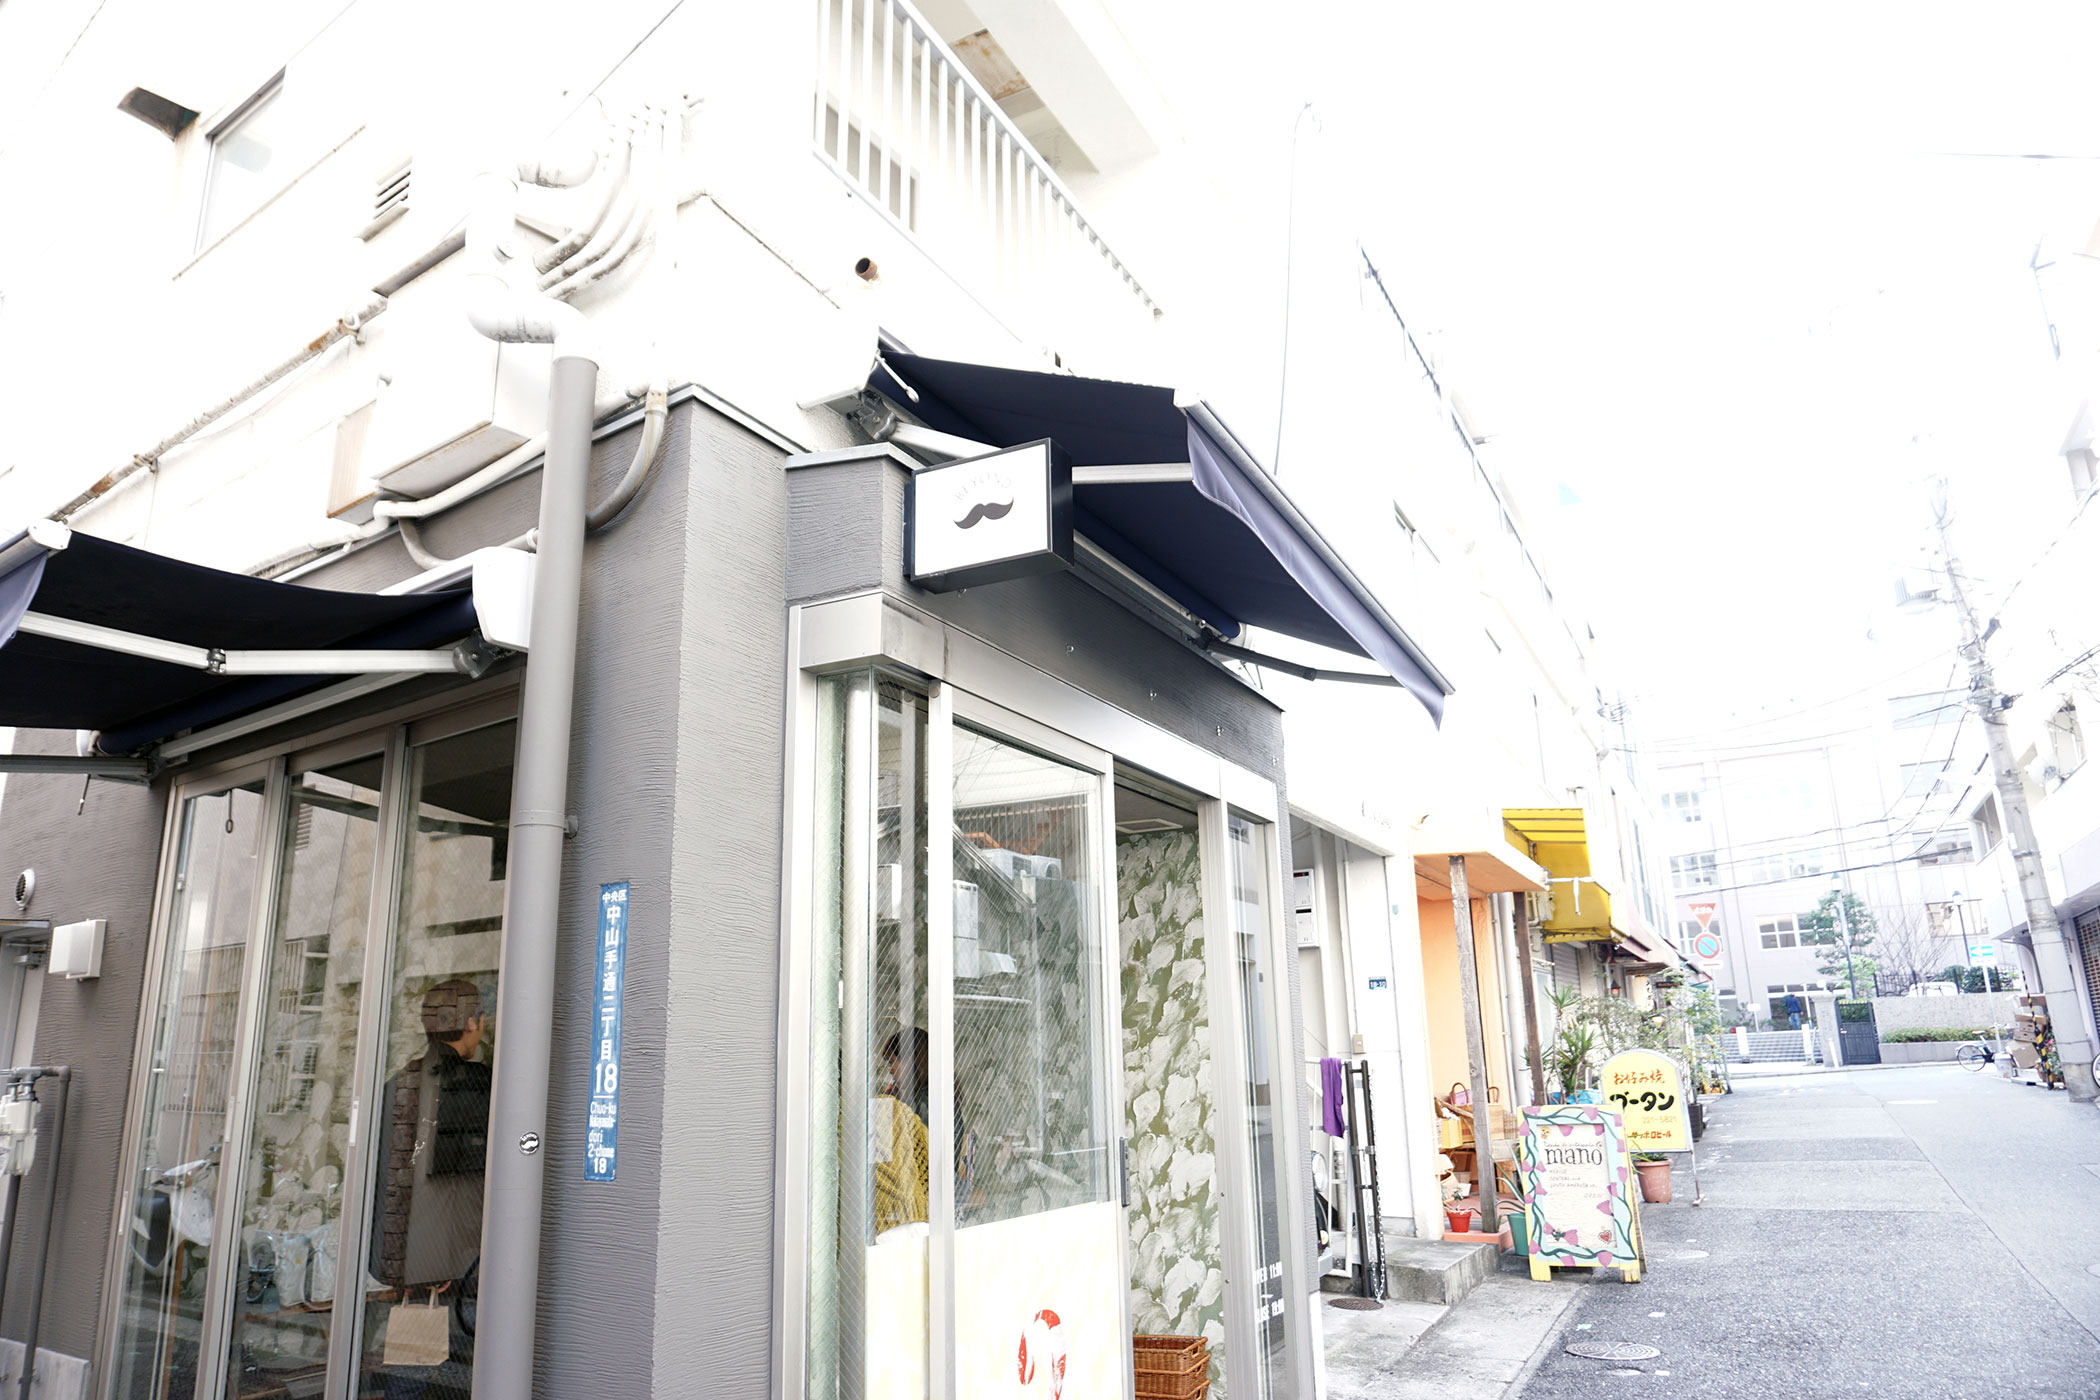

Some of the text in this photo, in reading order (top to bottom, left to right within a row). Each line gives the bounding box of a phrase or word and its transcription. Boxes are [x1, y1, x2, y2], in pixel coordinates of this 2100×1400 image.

[954, 472, 1012, 501] BEYOND
[602, 889, 627, 903] 中央区
[600, 904, 621, 1060] 中山手通二丁目
[595, 1063, 618, 1093] 18
[588, 1130, 603, 1143] dori
[587, 1143, 615, 1158] 2-chome
[1544, 1148, 1603, 1166] mano
[593, 1157, 607, 1174] 18
